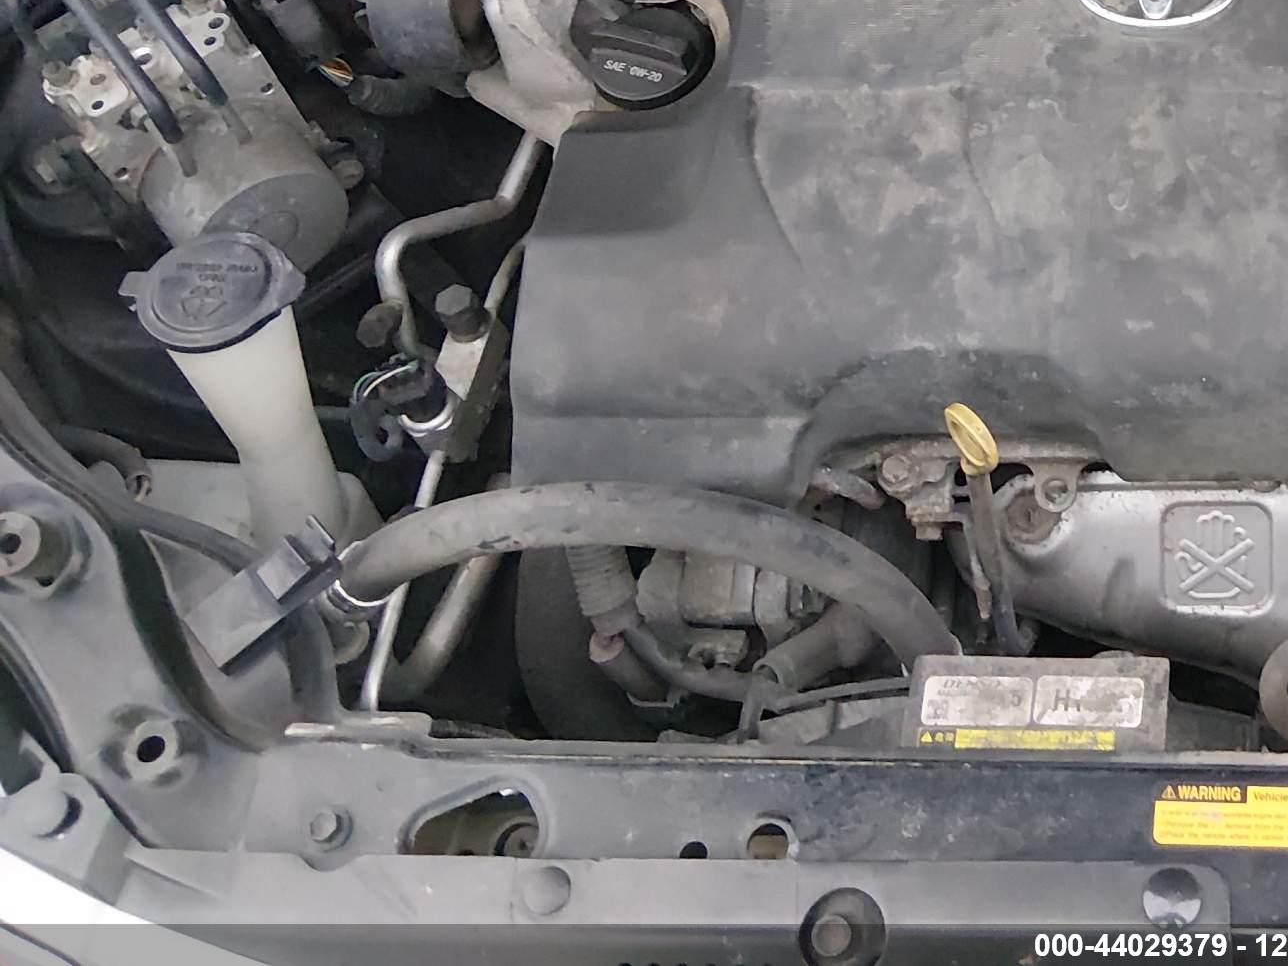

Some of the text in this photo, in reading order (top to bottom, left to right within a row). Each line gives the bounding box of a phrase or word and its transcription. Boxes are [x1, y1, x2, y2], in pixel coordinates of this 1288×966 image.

[603, 60, 663, 82] SAE 0W-20
[1178, 785, 1242, 801] WARNING
[1254, 791, 1288, 802] Vehicle
